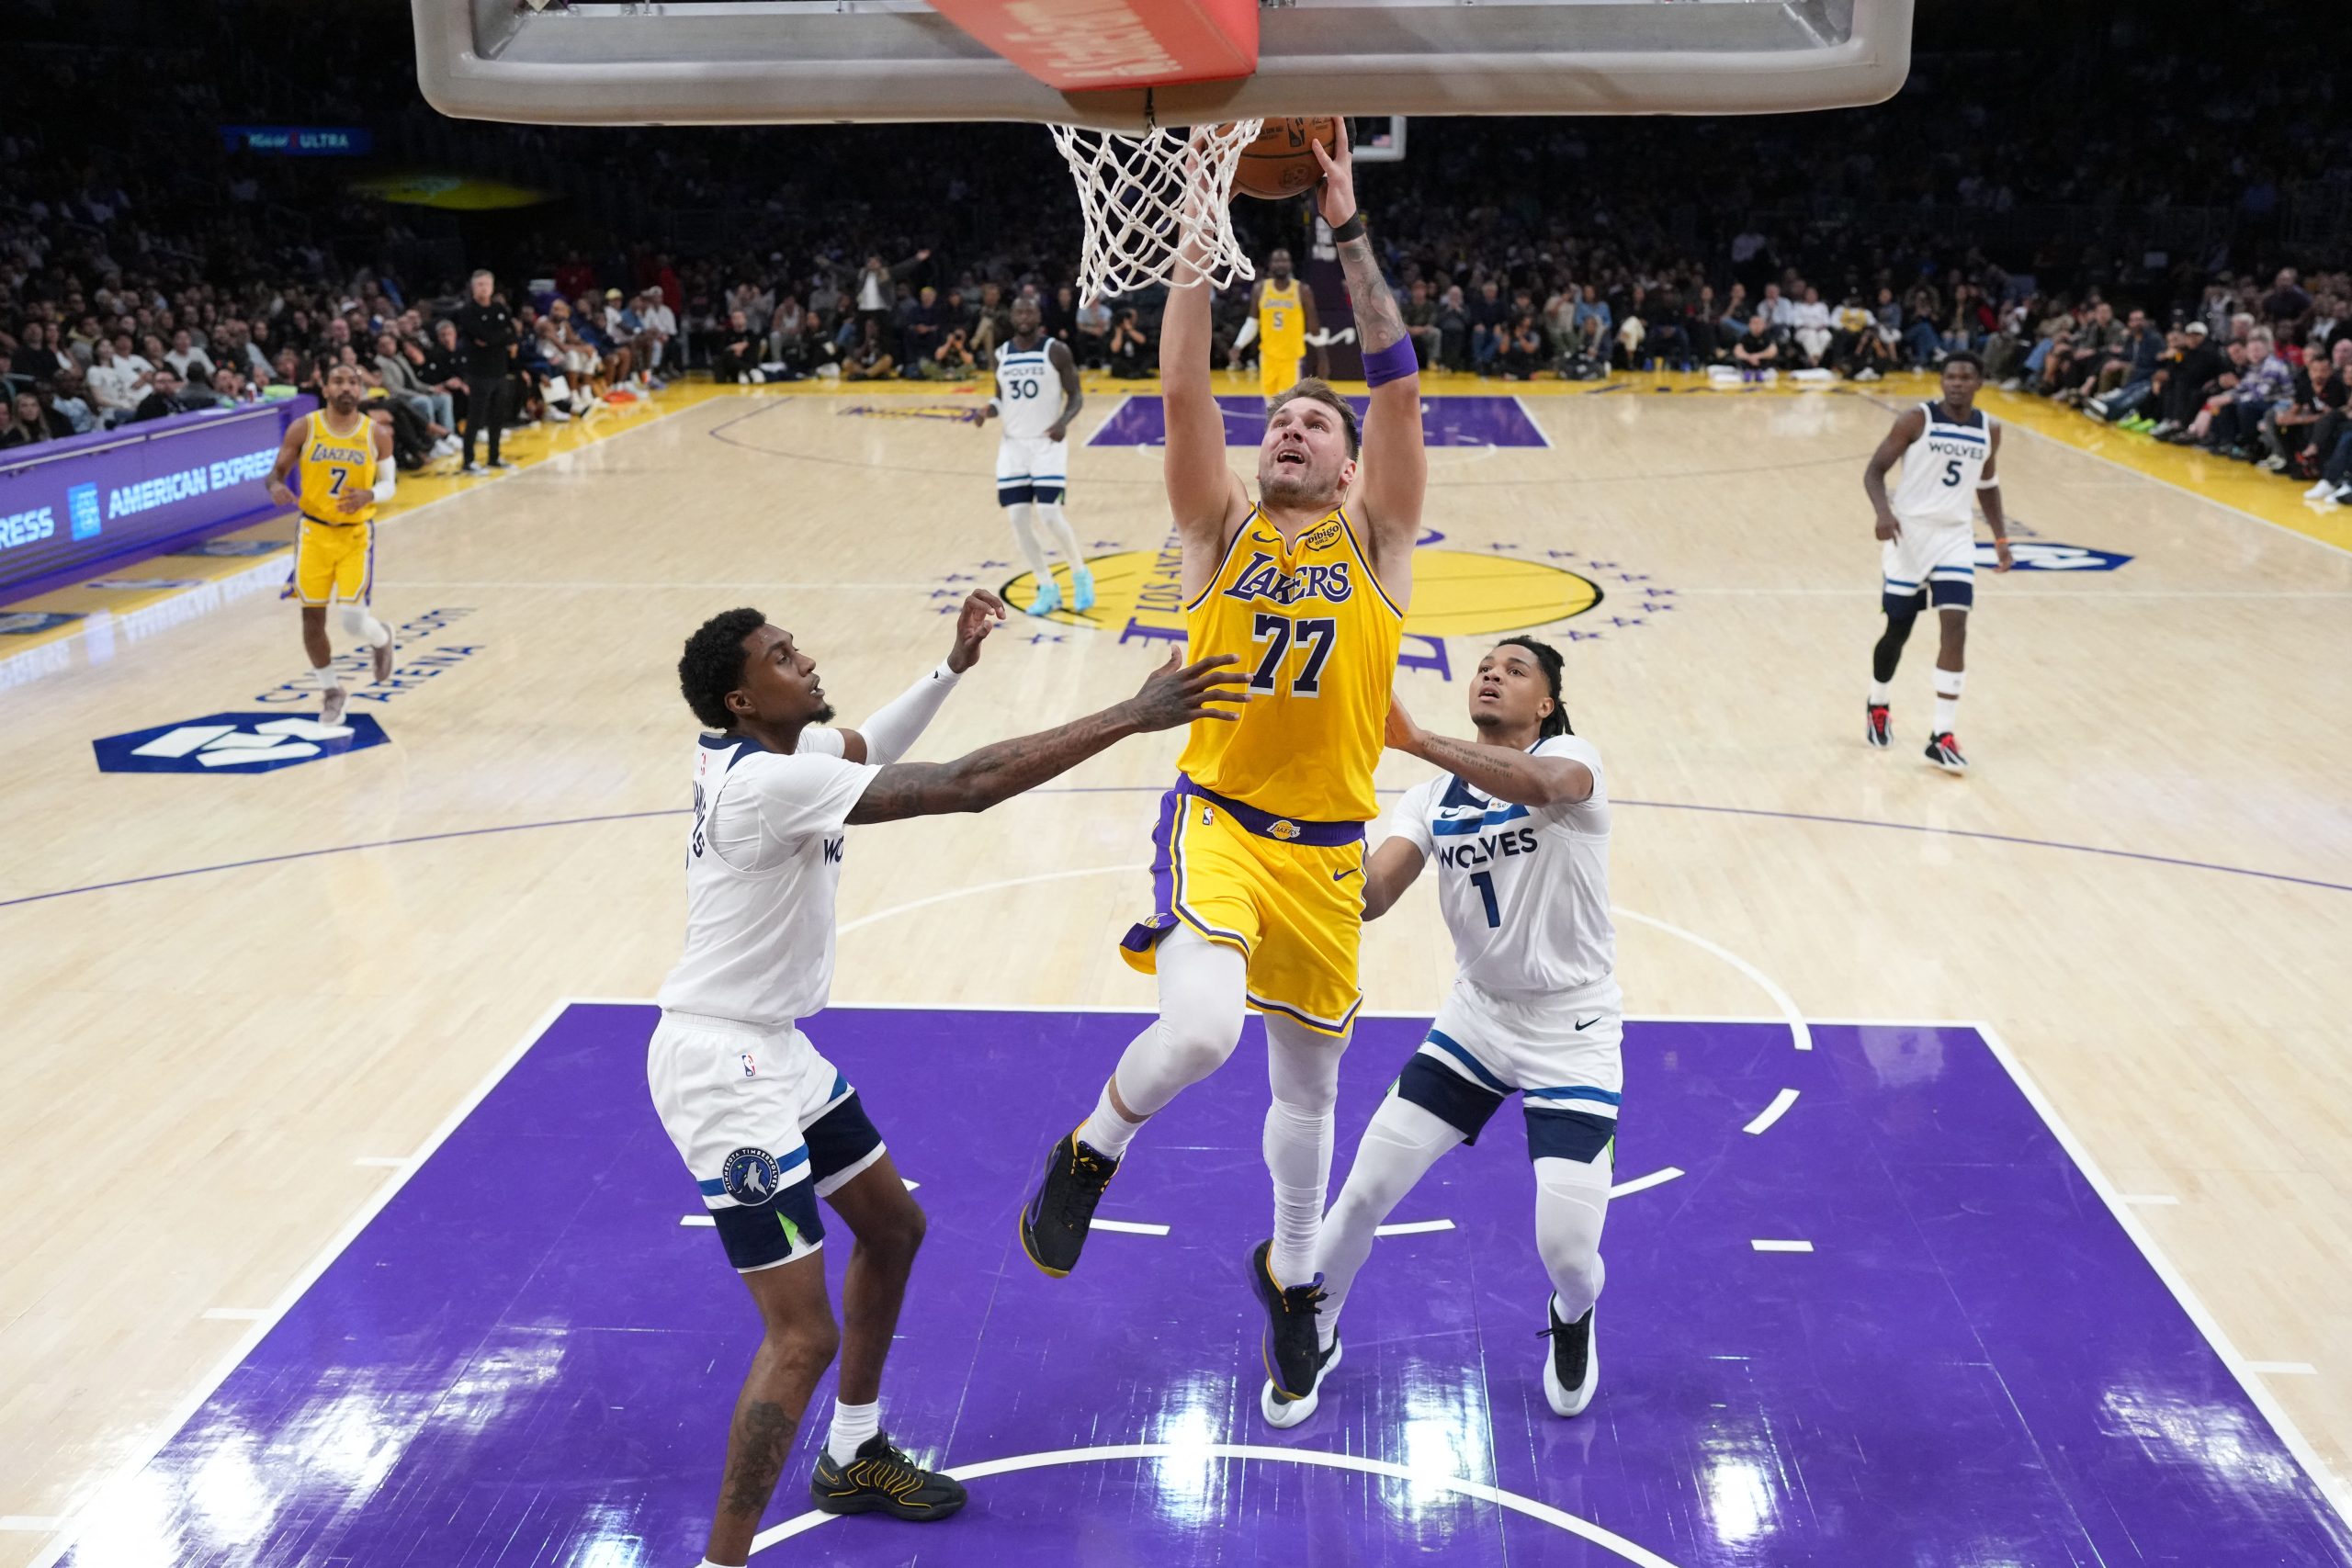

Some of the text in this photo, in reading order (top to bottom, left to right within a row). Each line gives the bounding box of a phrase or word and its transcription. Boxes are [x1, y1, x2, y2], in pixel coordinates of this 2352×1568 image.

[299, 133, 349, 149] ULTRA
[1009, 378, 1038, 400] 30
[310, 443, 367, 466] LAKERS
[1929, 441, 1984, 460] WOLVES
[108, 466, 208, 520] AMERICAN
[329, 467, 347, 497] 7
[1941, 460, 1962, 487] 5
[1221, 551, 1353, 605] LAKERS
[351, 645, 486, 704] ARENA
[1247, 612, 1337, 699] 77
[1437, 827, 1538, 870] WOLVES
[1470, 870, 1501, 929] 1
[724, 1149, 778, 1191] MINNESOTA TIMBERWOLVES
